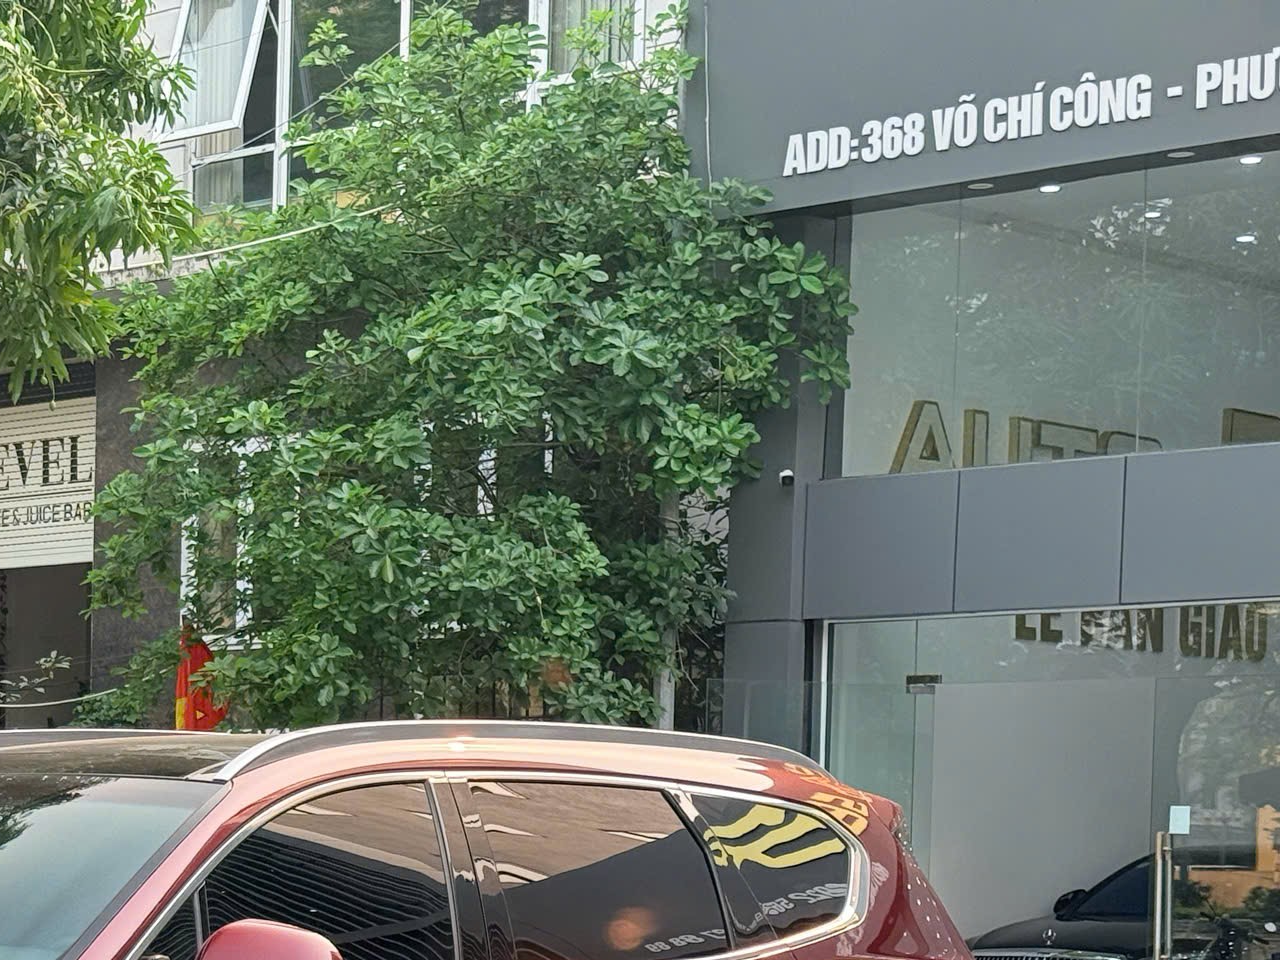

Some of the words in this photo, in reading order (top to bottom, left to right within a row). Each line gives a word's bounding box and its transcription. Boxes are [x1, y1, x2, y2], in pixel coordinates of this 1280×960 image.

[932, 93, 978, 152] VÕ
[983, 81, 1046, 143] CHÍ
[1049, 71, 1152, 132] CÔNG
[1195, 46, 1280, 110] PHƯ
[23, 502, 61, 525] JUICE
